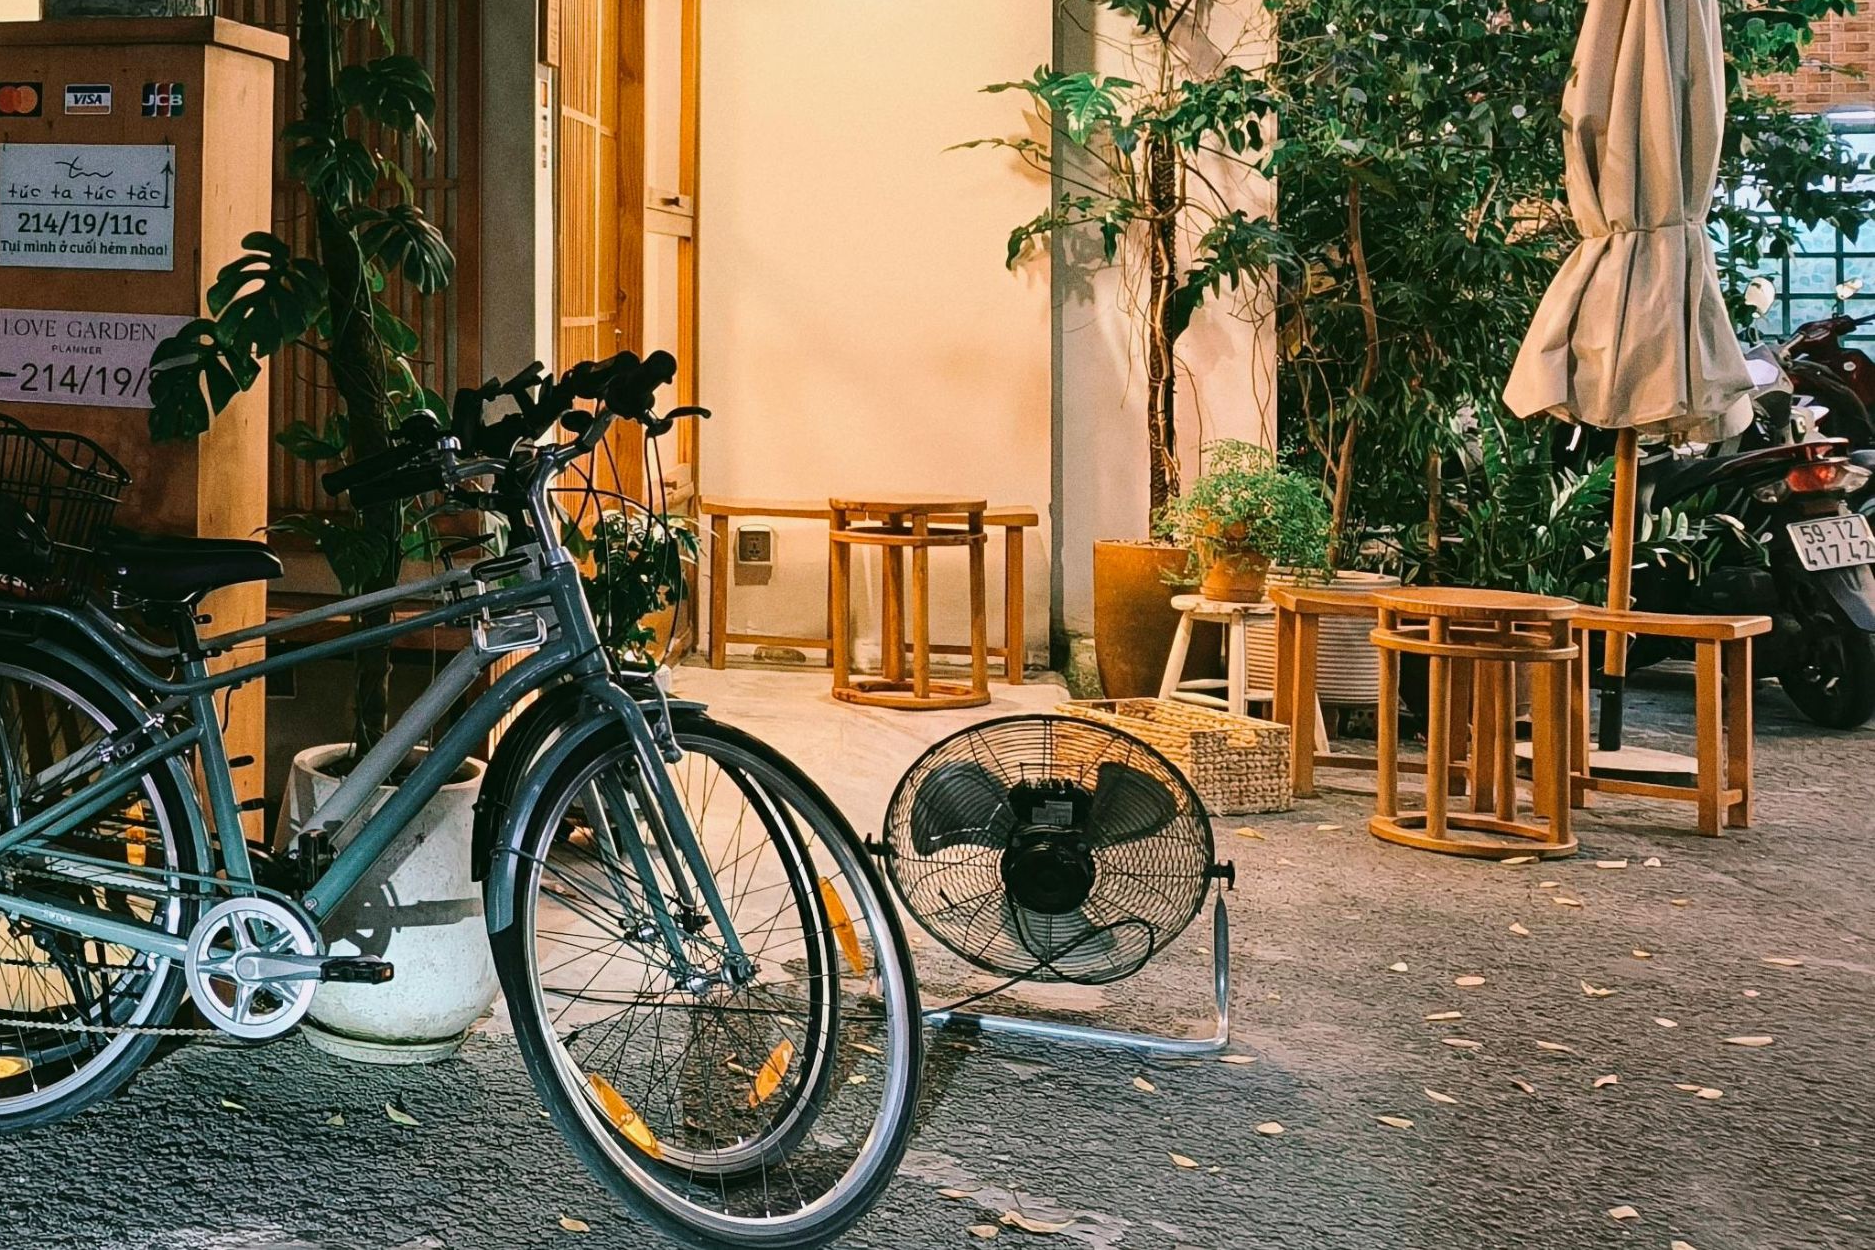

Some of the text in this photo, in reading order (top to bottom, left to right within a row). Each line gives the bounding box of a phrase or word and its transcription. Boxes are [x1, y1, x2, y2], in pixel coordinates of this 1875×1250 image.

[73, 94, 102, 105] VISA
[141, 94, 183, 106] JCB
[51, 184, 73, 200] ta
[4, 318, 157, 341] LOVE GARDEN
[52, 344, 102, 356] PLANNER
[20, 363, 155, 397] 214/19/
[1799, 520, 1860, 545] 59-T2
